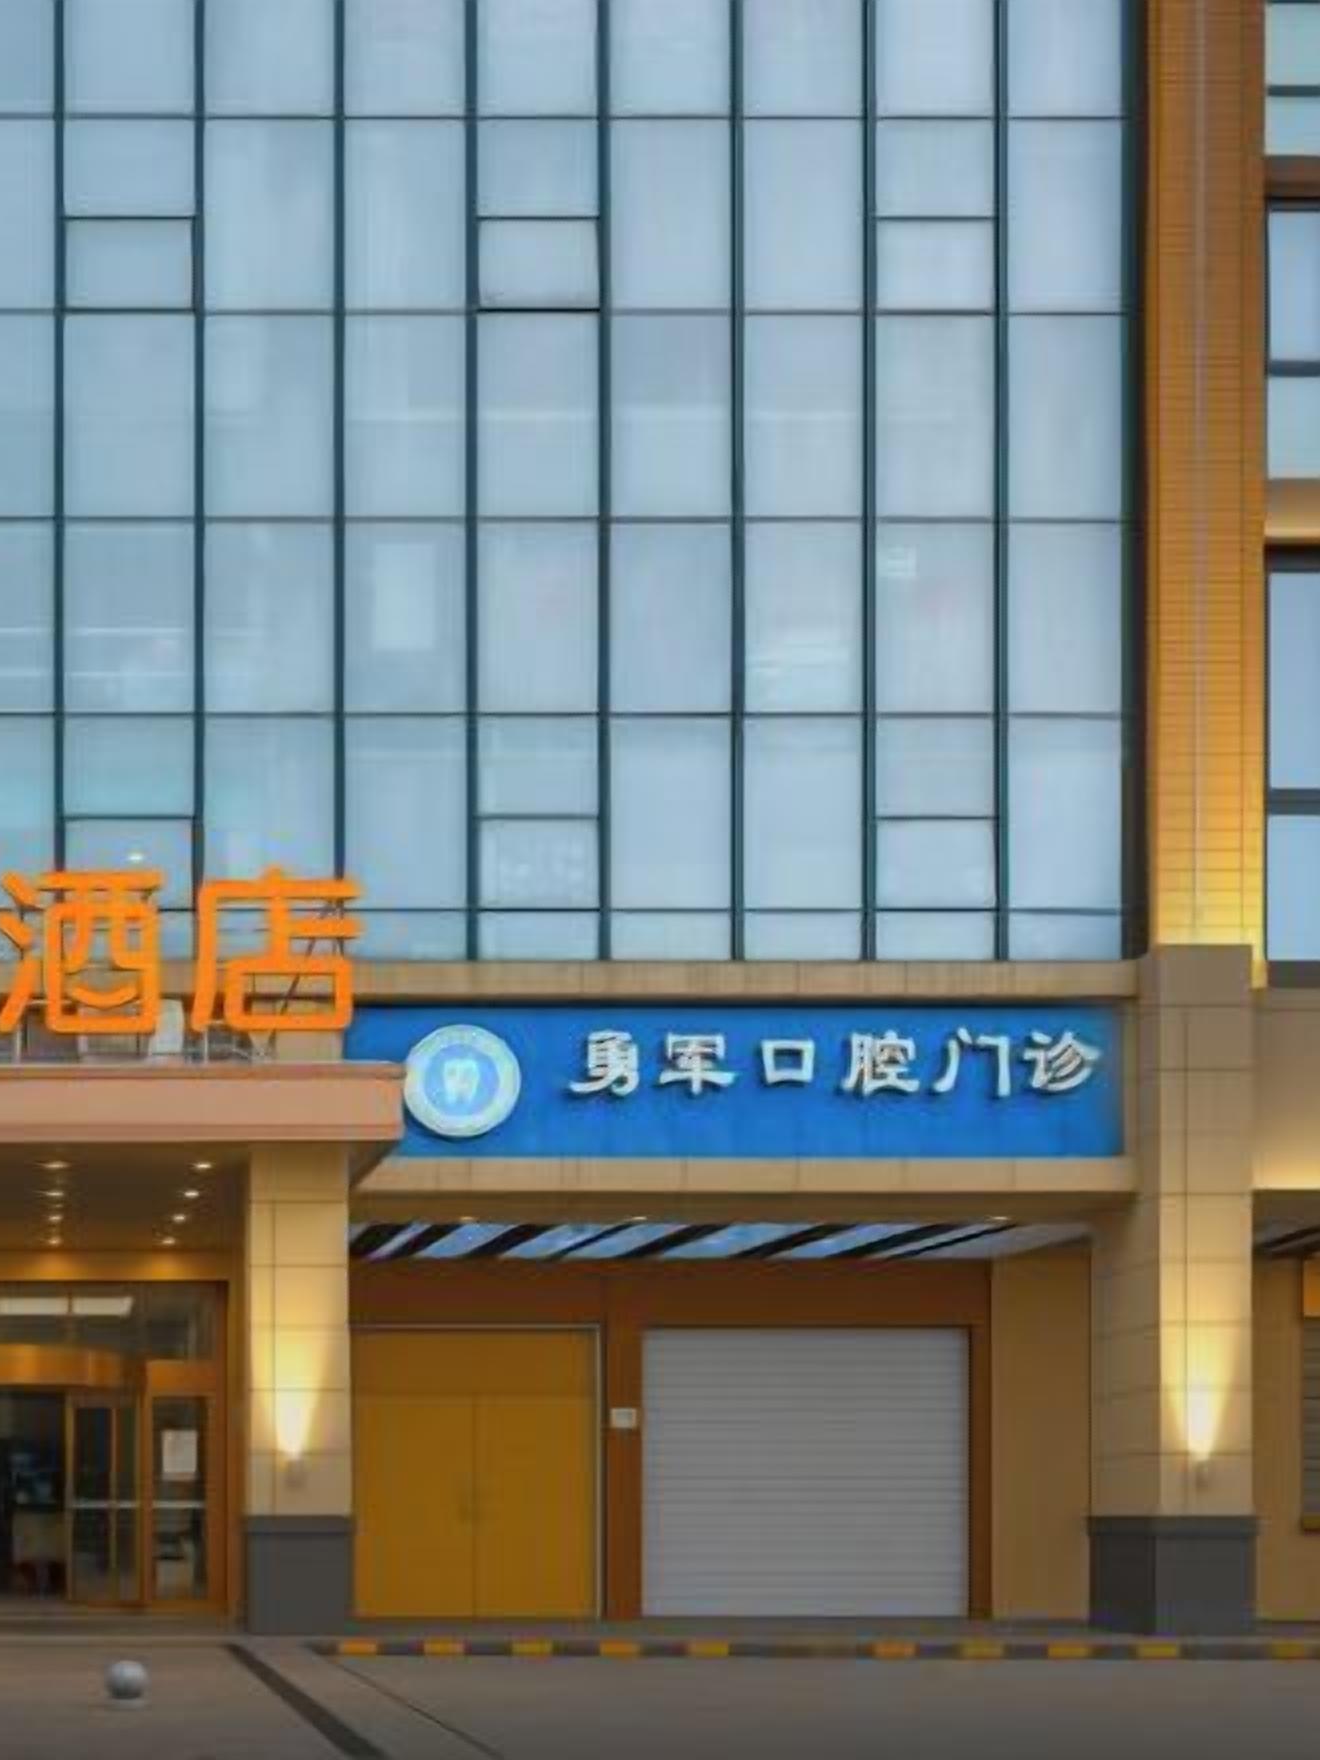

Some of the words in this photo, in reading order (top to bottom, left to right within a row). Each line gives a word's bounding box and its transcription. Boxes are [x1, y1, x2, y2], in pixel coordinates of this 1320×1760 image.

[570, 1027, 1102, 1096] 勇军口腔门诊
